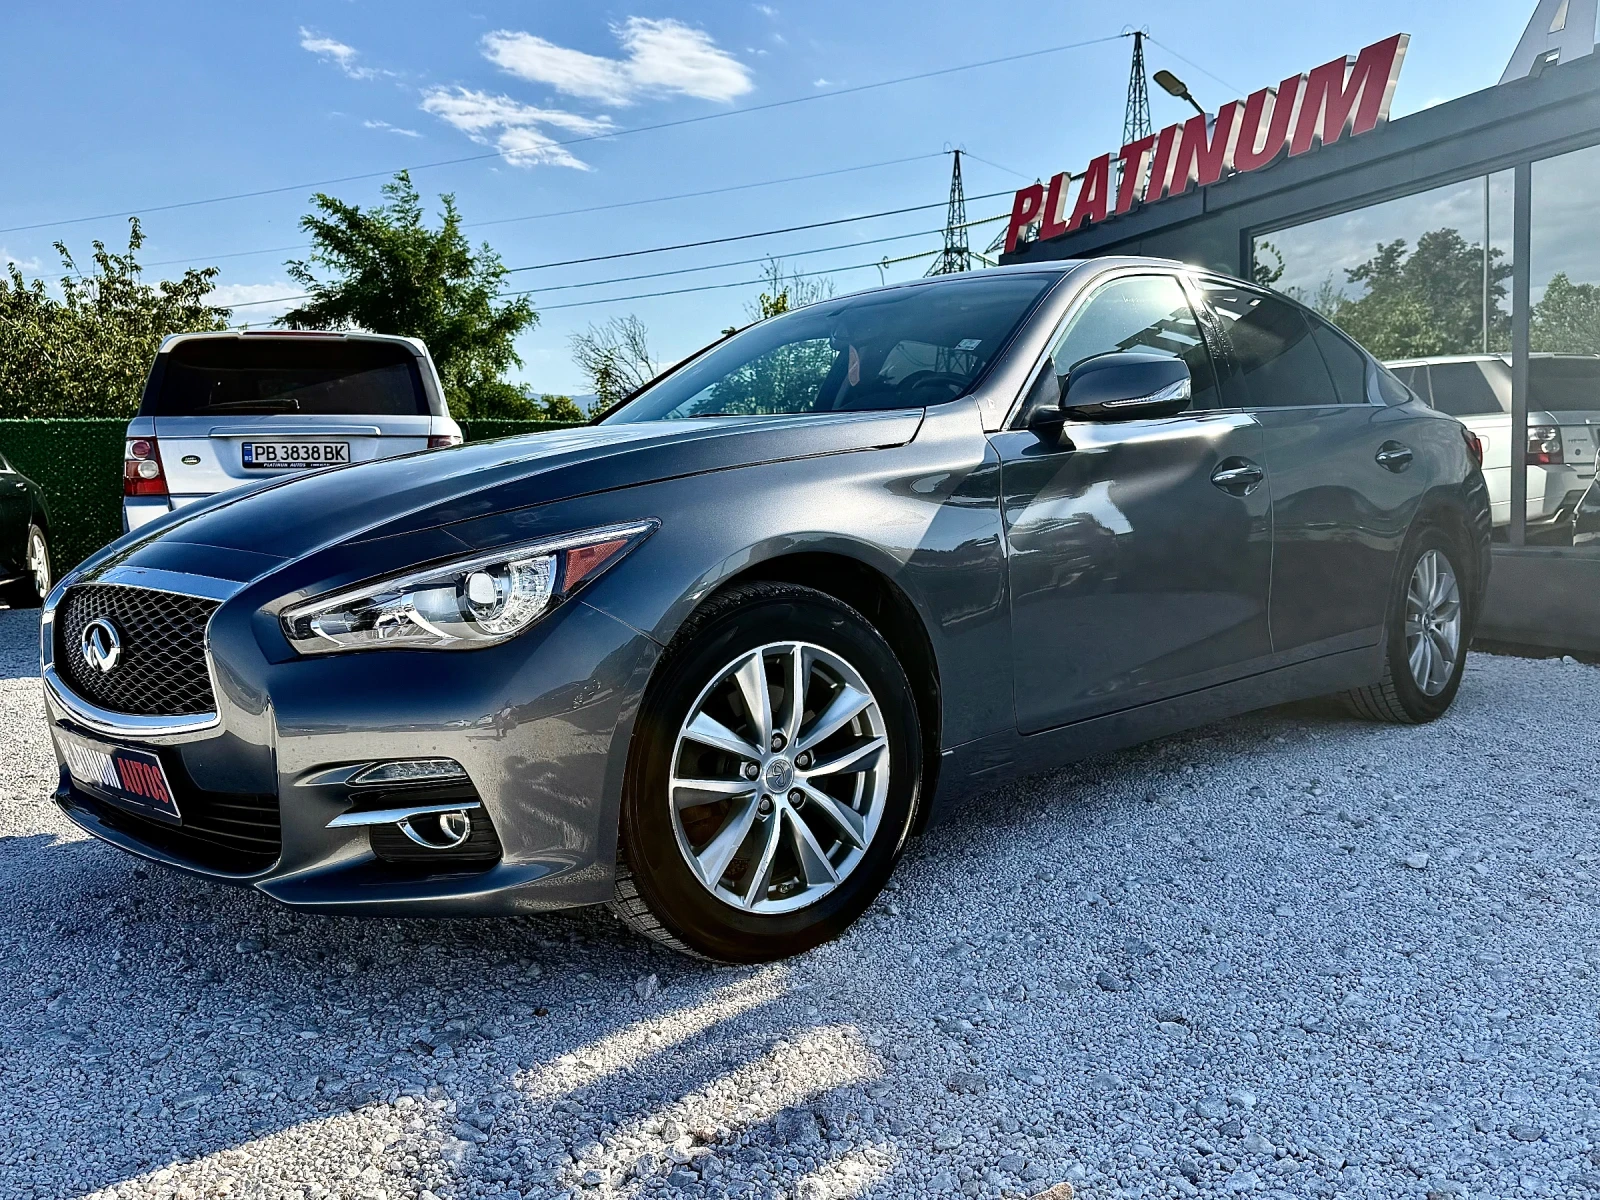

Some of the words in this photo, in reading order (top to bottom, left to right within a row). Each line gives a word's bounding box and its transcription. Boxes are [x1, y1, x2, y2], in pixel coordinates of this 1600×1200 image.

[1005, 33, 1408, 253] PLATINUM
[254, 445, 278, 461] PB
[280, 445, 324, 461] 3838
[323, 445, 346, 461] BK
[117, 757, 169, 804] AUTOS
